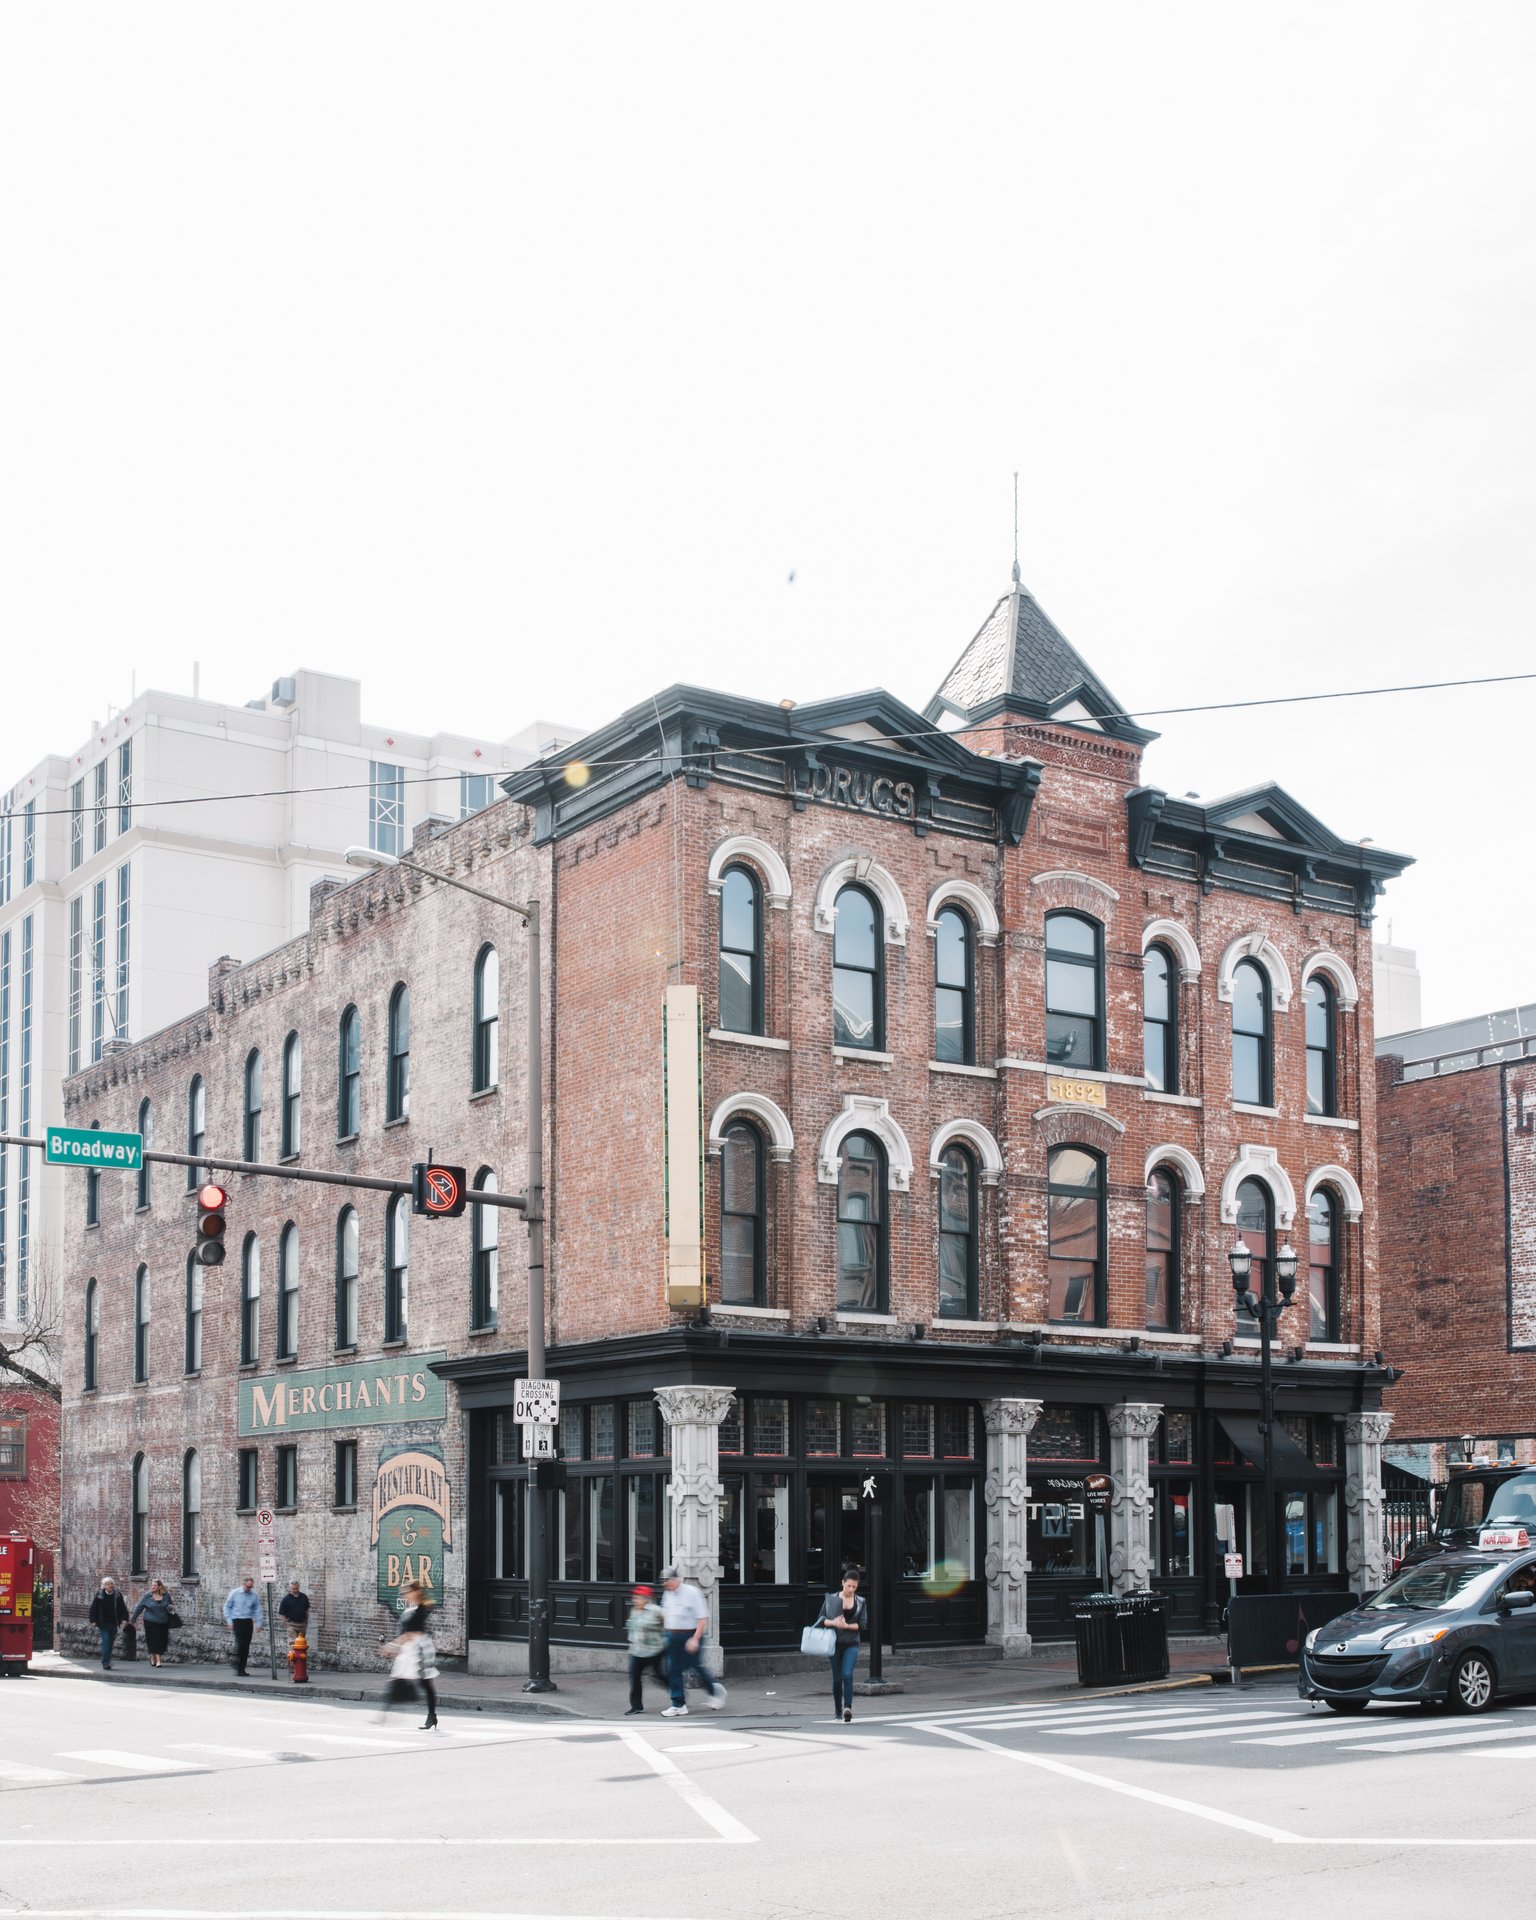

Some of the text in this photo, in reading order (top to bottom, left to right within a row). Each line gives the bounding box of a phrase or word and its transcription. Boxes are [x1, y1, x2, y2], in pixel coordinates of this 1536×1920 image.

[812, 762, 914, 815] DRUGS
[51, 1136, 136, 1164] Broadway
[250, 1372, 426, 1429] MERCHANTS
[521, 1382, 554, 1390] DIAGONAL
[521, 1391, 554, 1399] CROSSING
[516, 1402, 533, 1417] OK
[379, 1464, 443, 1511] RESTAURANT
[401, 1516, 417, 1547] &
[386, 1553, 434, 1588] BAR
